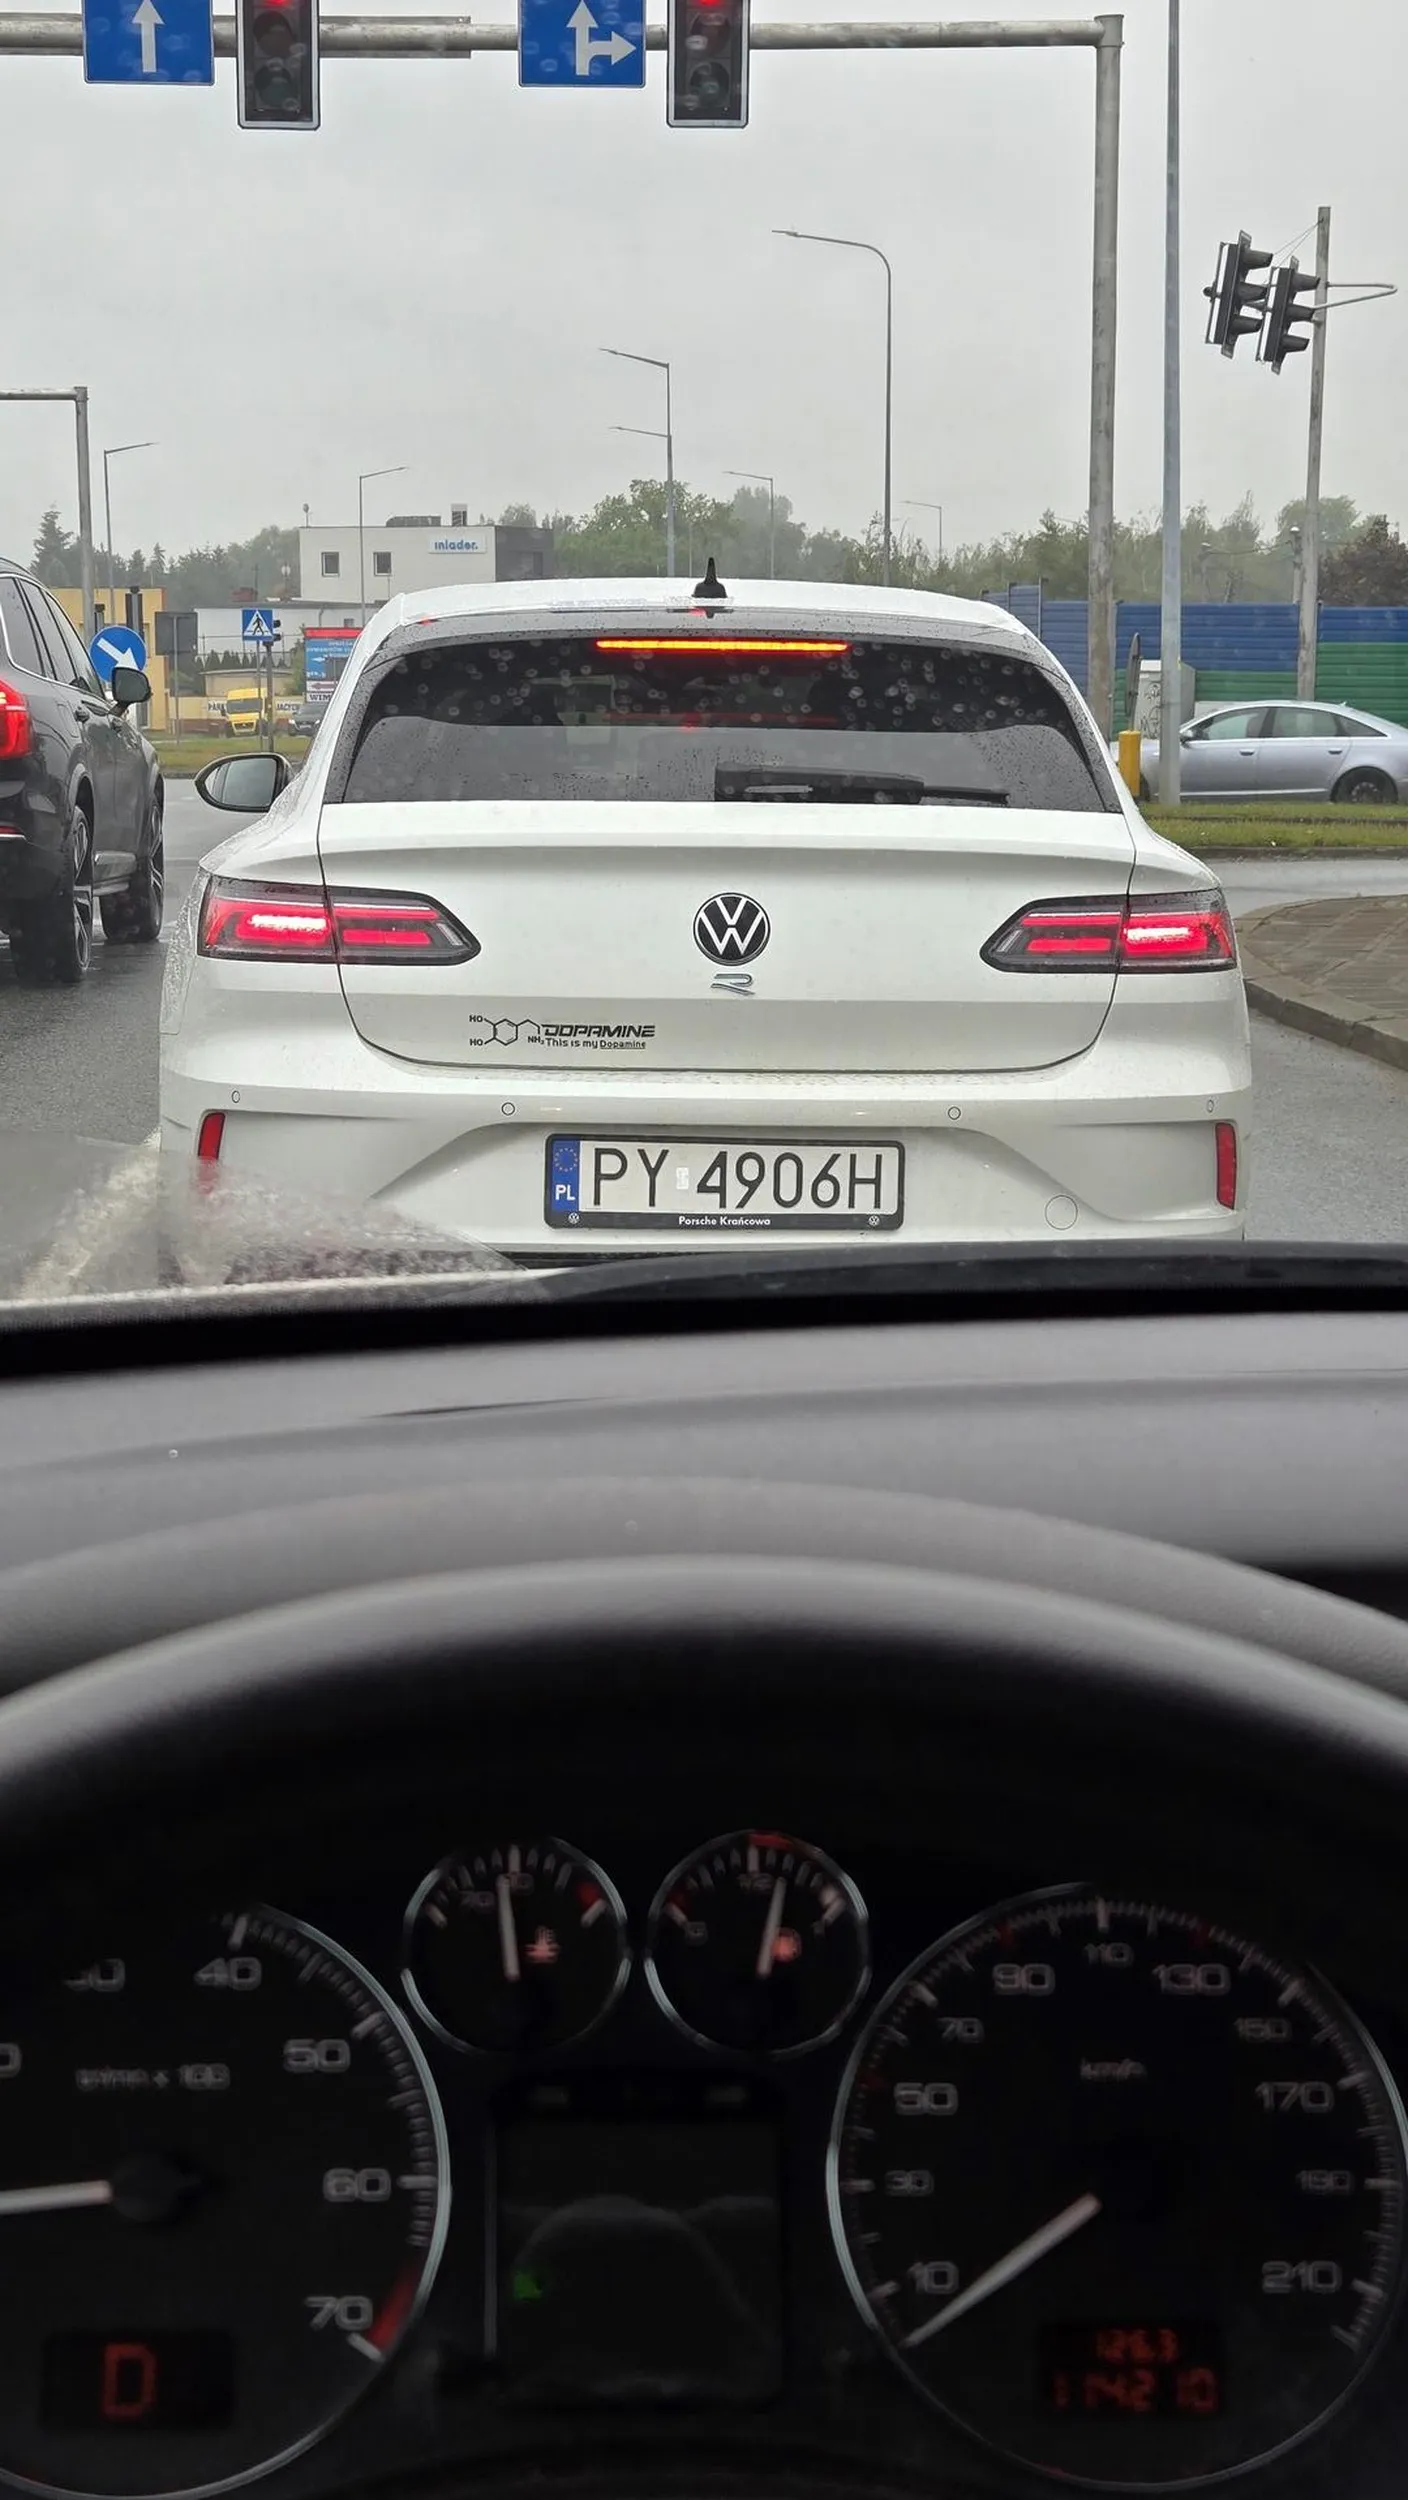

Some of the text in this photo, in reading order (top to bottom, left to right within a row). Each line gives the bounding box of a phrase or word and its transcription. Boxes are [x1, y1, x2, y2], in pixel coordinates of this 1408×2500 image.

[469, 1015, 483, 1023] HO
[541, 1024, 656, 1038] DOPAMINE
[470, 1038, 483, 1046] HO
[545, 1037, 646, 1049] This is my Dopamine
[555, 1184, 576, 1201] PL
[594, 1147, 882, 1209] PY 4906H
[678, 1215, 771, 1226] Porsche Krańcowa
[1084, 1943, 1134, 1968] 110
[194, 1957, 261, 1991] 40
[992, 1963, 1056, 1996] 90
[1153, 1963, 1232, 1996] 130
[938, 2017, 985, 2043] 70
[283, 2039, 351, 2073] 50
[894, 2082, 958, 2116] 50
[1256, 2081, 1334, 2113] 170
[323, 2167, 391, 2202] 60
[885, 2170, 934, 2196] 30
[907, 2260, 959, 2294] 10
[1262, 2260, 1342, 2294] 210
[305, 2296, 373, 2331] 70
[104, 2343, 156, 2420] D
